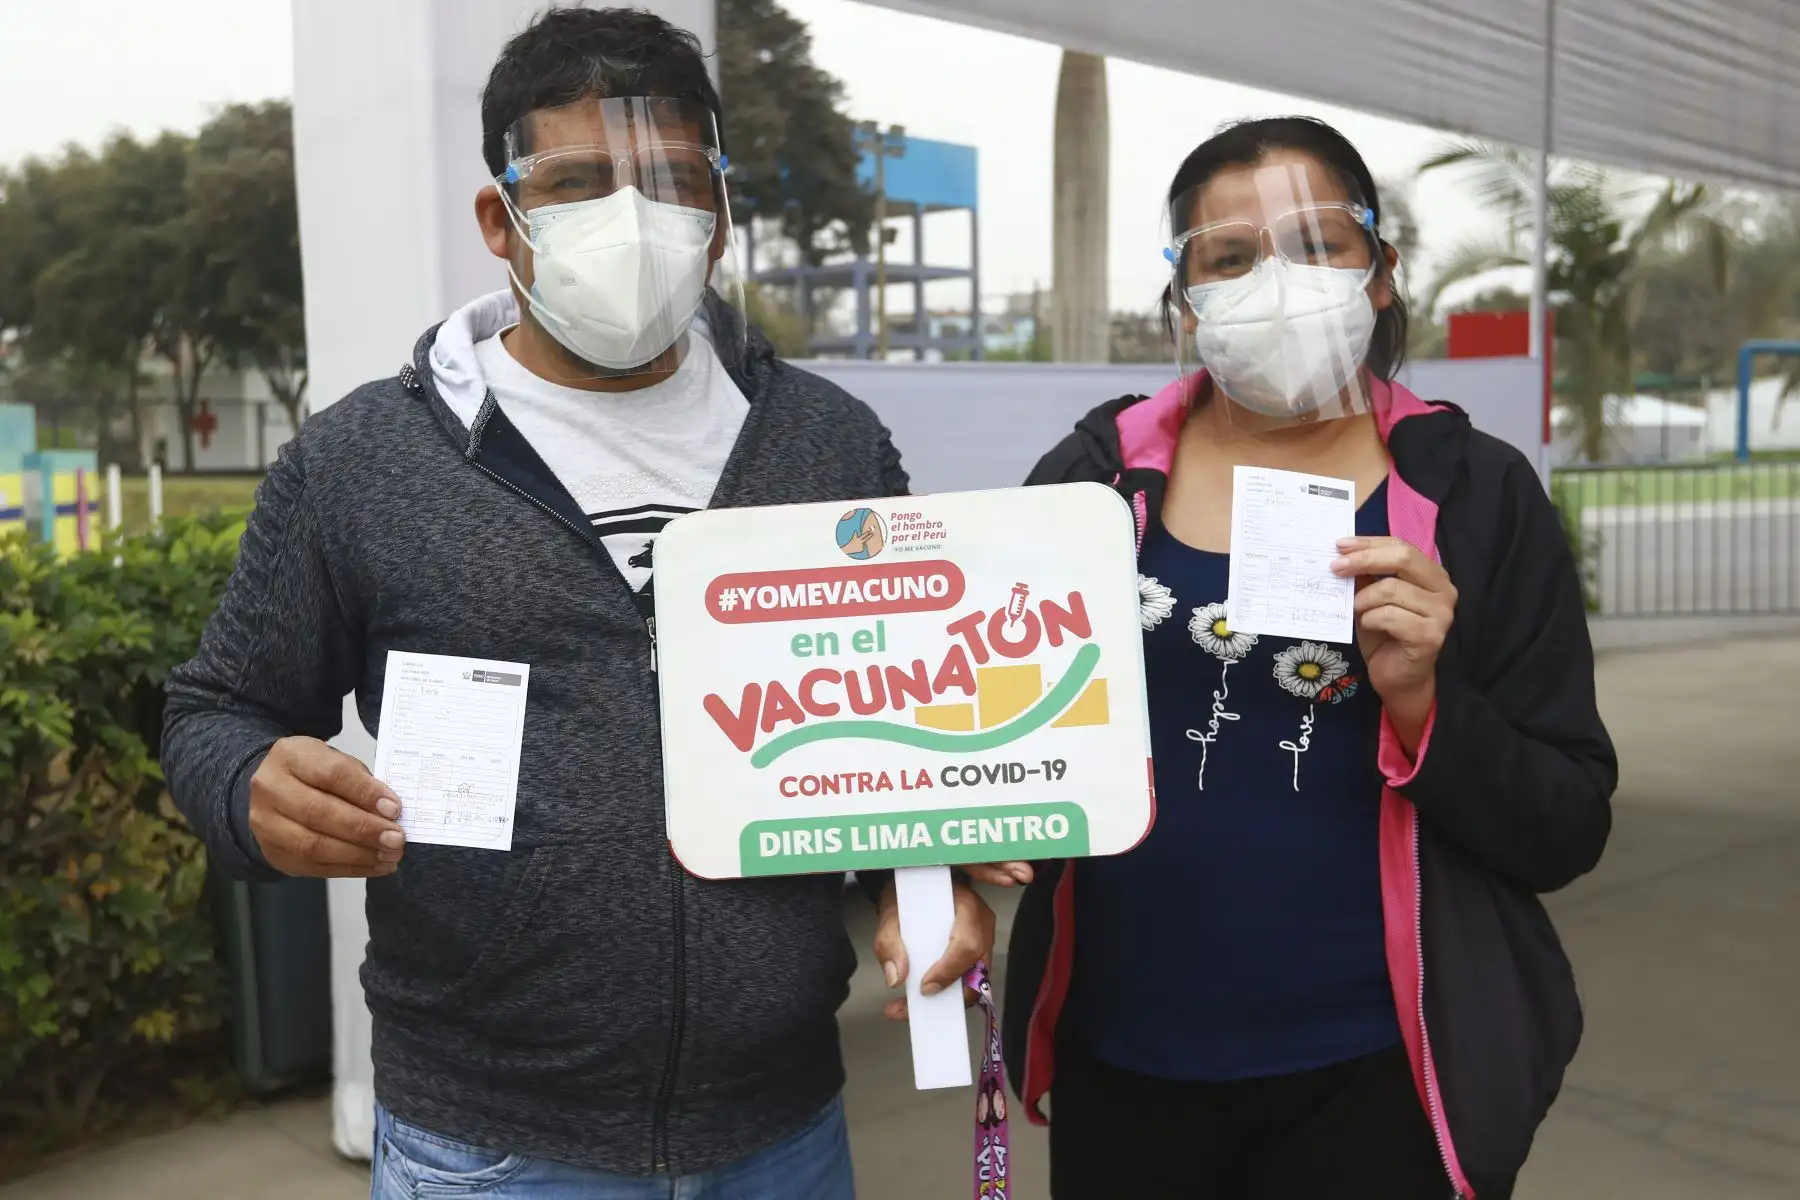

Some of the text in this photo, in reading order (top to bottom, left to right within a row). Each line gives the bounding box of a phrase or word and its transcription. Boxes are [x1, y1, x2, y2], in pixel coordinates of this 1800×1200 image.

[890, 512, 922, 523] Pongo
[891, 520, 943, 531] el hombro
[891, 529, 947, 545] por el Perú
[916, 544, 941, 552] VACUNO
[718, 573, 949, 612] #YOMEVACUNO
[790, 619, 888, 658] en el
[1279, 704, 1314, 752] love
[778, 758, 1068, 798] CONTRA LA COVID-19
[758, 813, 1070, 858] DIRIS LIMA CENTRO
